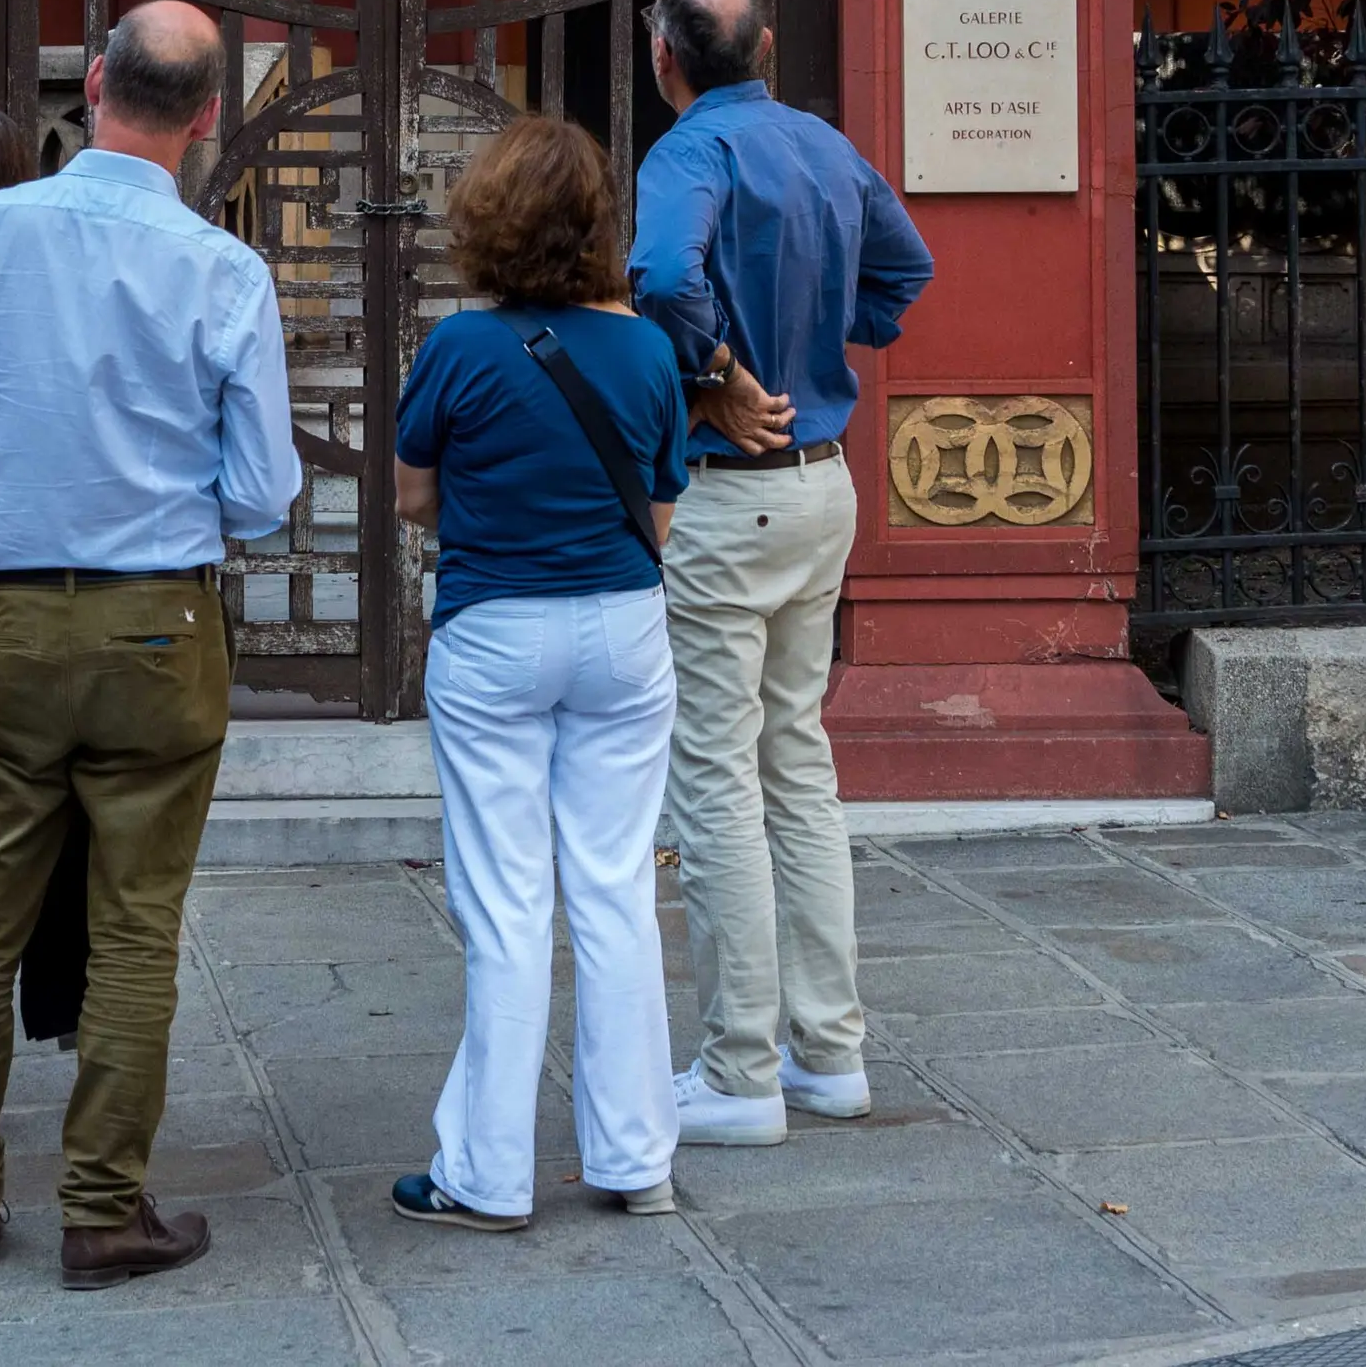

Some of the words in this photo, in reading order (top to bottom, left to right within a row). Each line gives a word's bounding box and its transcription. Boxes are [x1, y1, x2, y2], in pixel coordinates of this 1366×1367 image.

[959, 12, 1023, 25] GALERIE
[968, 41, 1010, 60] LOO
[1014, 48, 1025, 60] &
[943, 101, 982, 115] ARTS
[952, 129, 1032, 140] DECORATION
